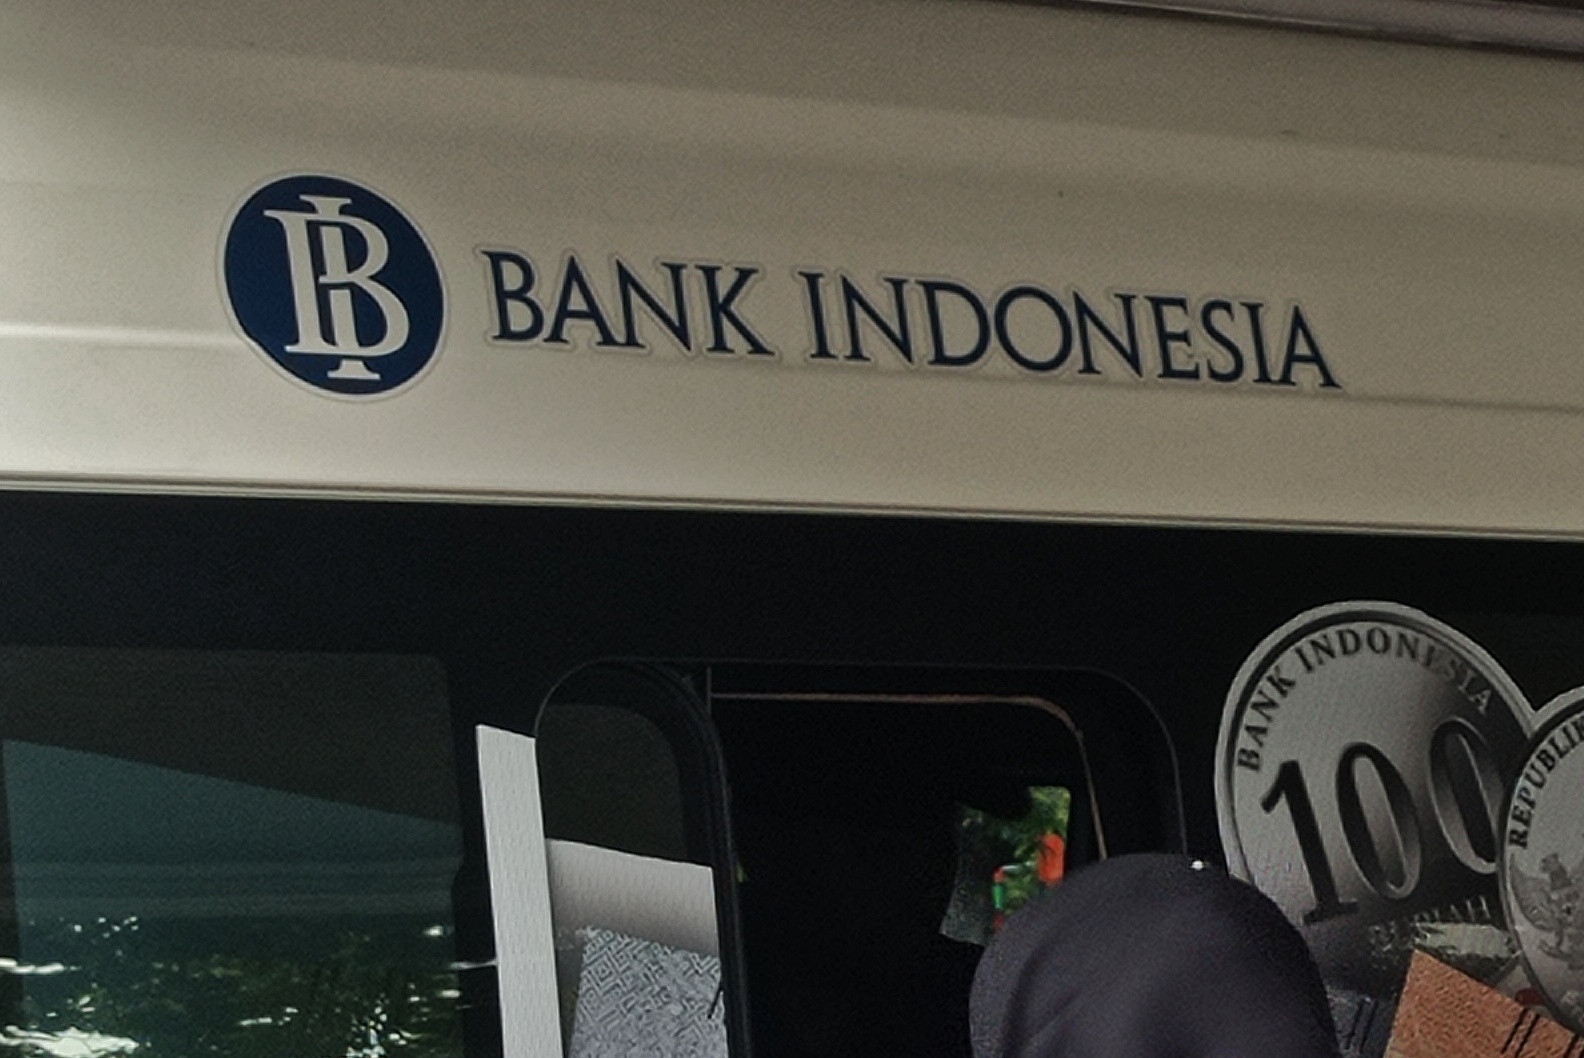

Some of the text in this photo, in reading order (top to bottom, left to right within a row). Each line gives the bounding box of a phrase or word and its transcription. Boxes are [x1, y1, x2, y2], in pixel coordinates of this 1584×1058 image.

[481, 248, 1342, 390] BANK INDONESIA
[1237, 664, 1297, 773] BANK
[1260, 715, 1498, 927] 100
